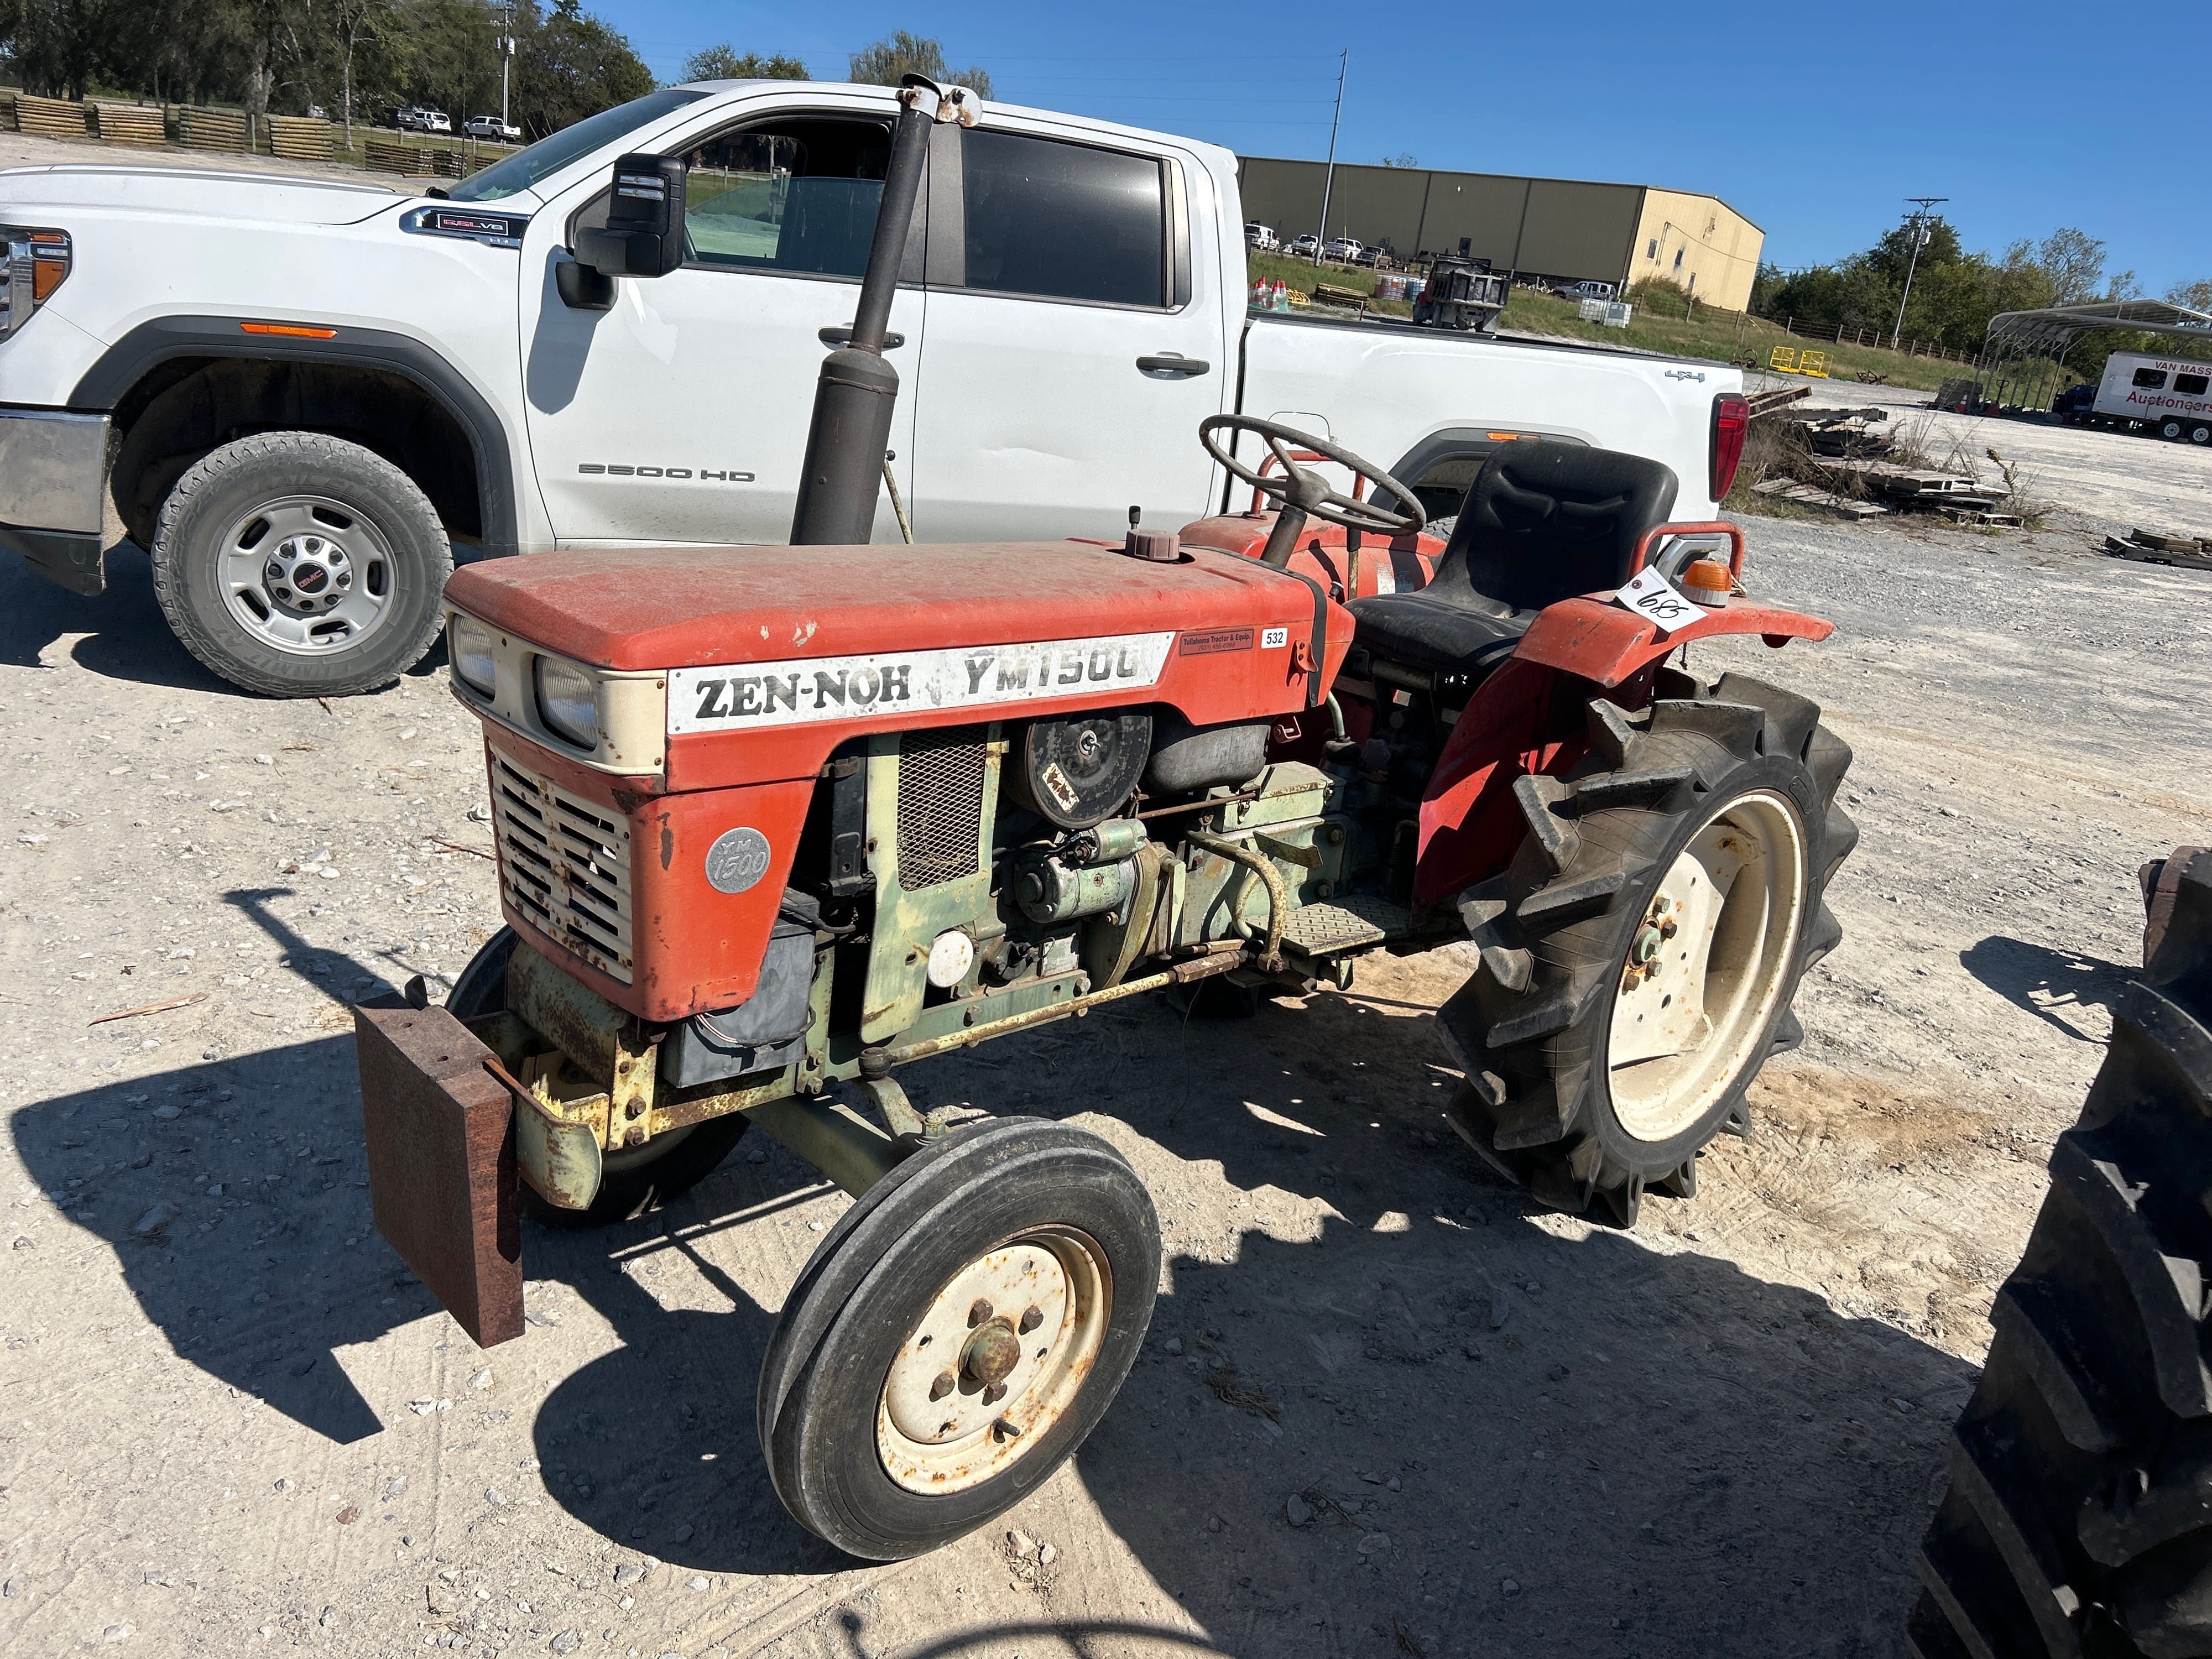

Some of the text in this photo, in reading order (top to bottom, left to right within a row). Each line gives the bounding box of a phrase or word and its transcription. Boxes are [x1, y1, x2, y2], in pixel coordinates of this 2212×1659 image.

[2156, 361, 2177, 371] VAN
[578, 463, 755, 482] 2500 HD
[297, 569, 324, 589] GMC
[1637, 589, 1689, 618] 685
[1184, 637, 1209, 646] Tullahoma
[1235, 633, 1251, 641] Equip.
[1266, 632, 1284, 645] 532
[695, 647, 1139, 719] ZEN-NOH YM1500
[721, 839, 752, 855] YM
[714, 852, 766, 881] 1500
